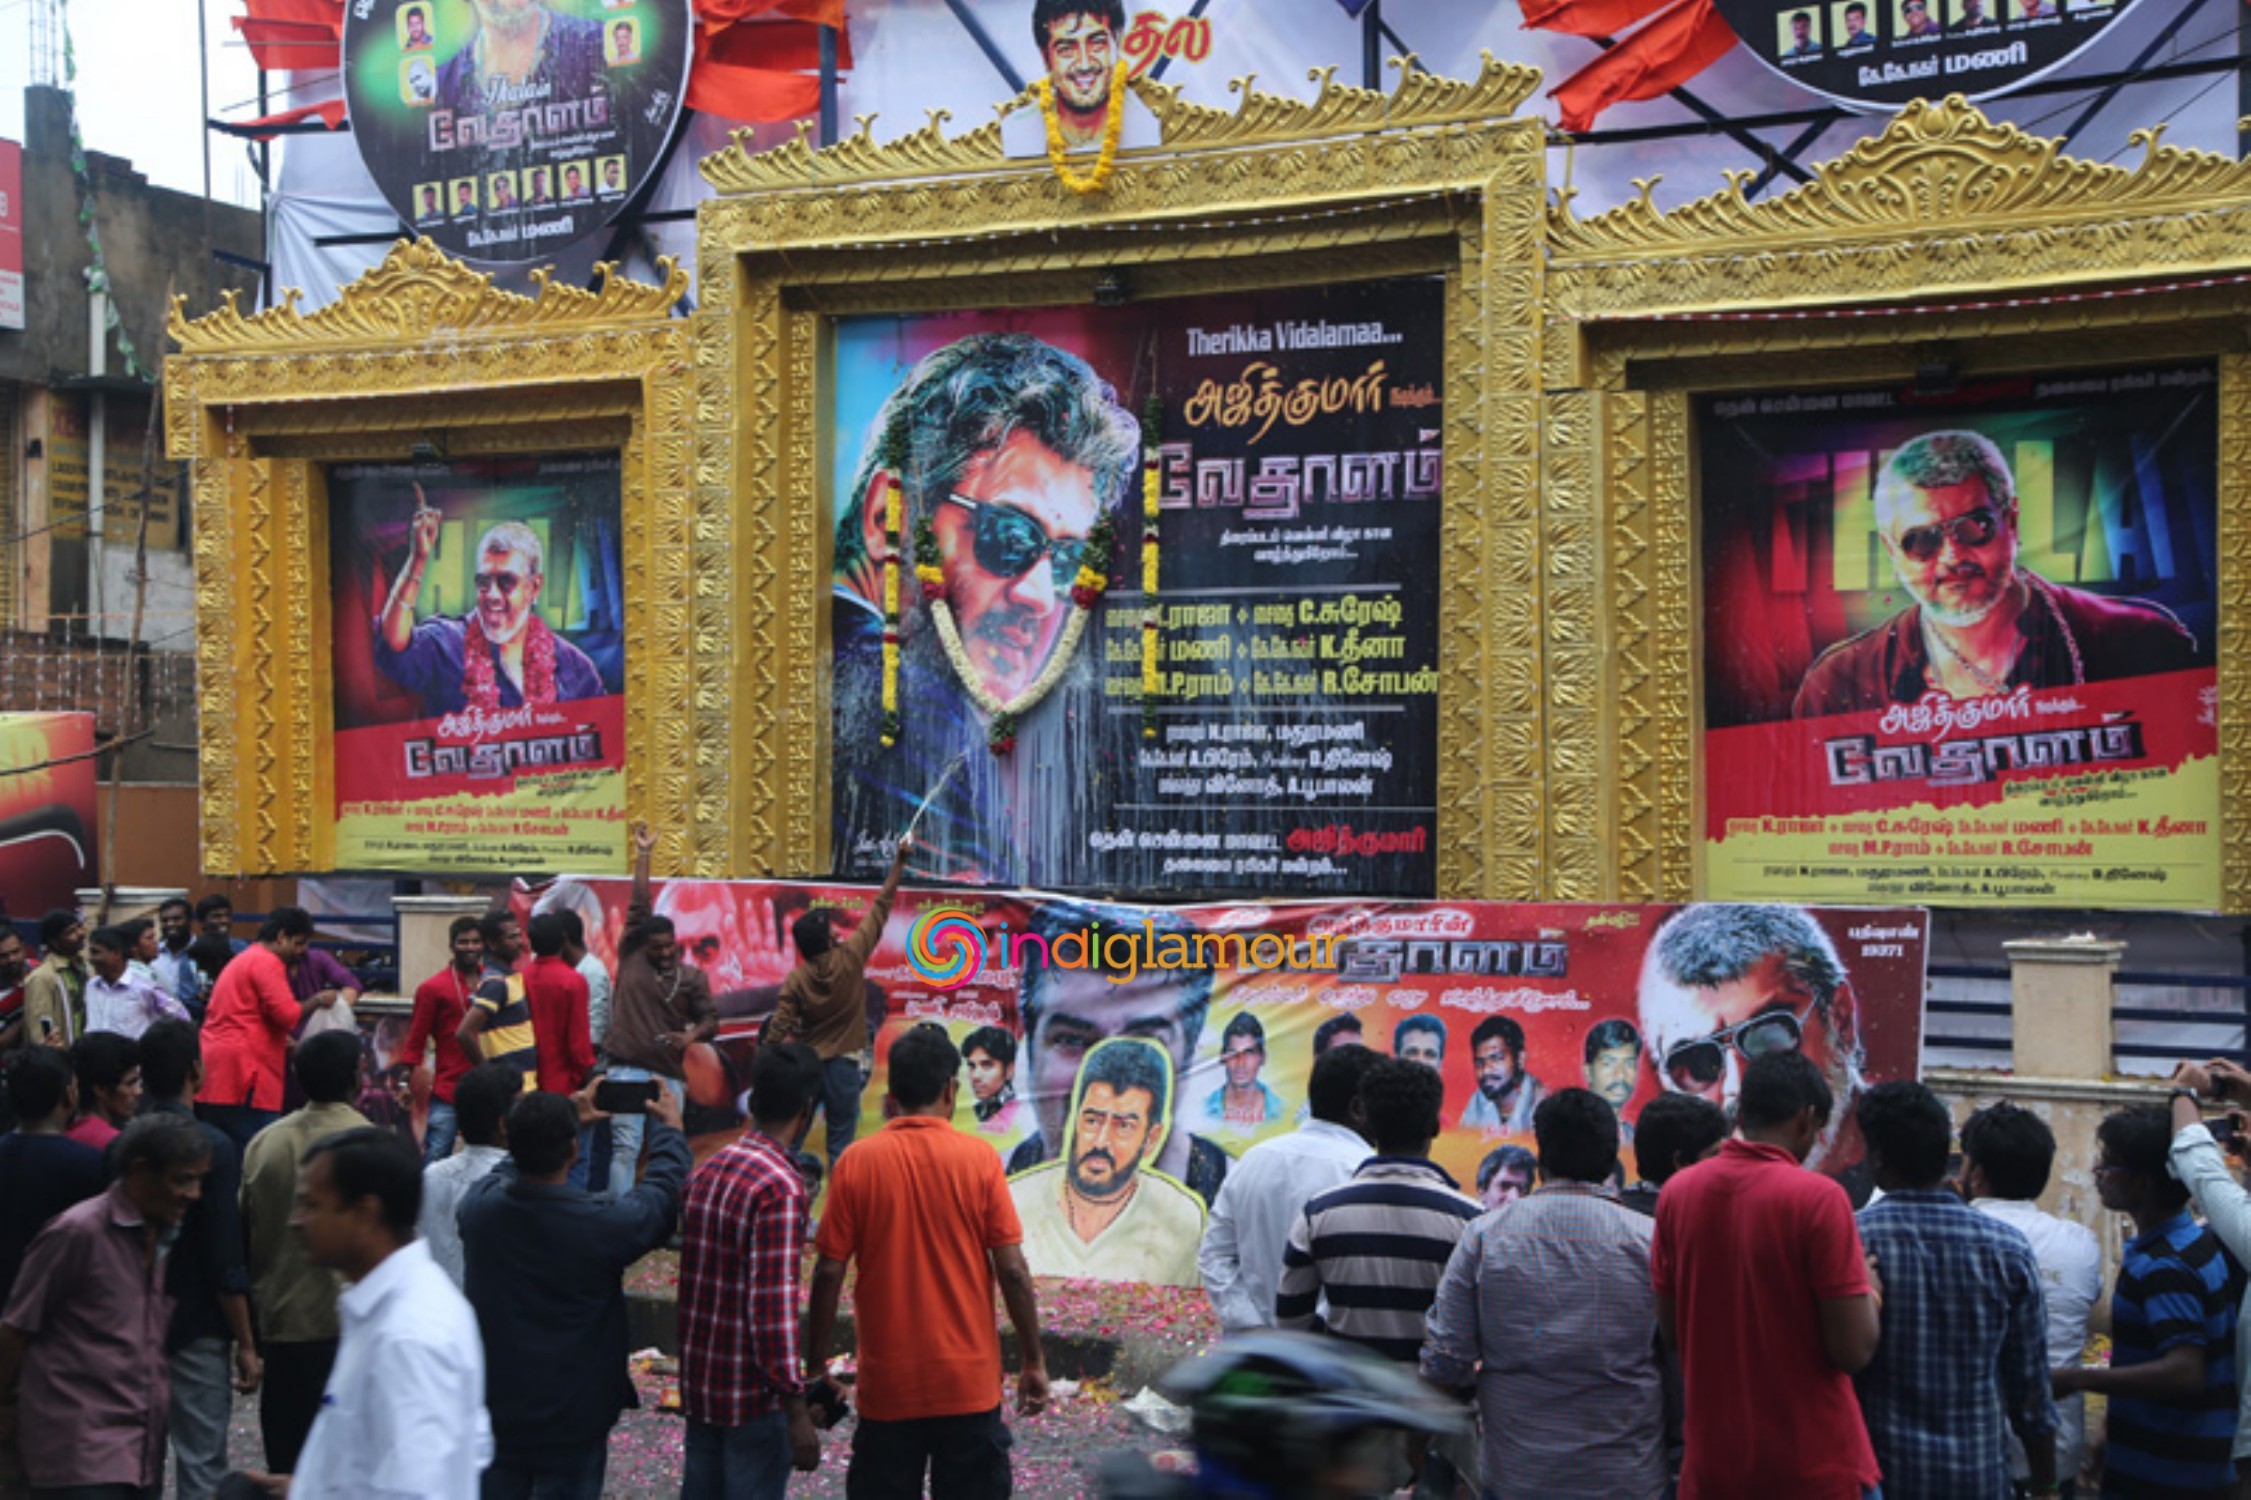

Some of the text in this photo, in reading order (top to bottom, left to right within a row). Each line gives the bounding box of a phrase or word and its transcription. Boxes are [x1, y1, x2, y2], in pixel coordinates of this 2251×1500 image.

[1123, 10, 1212, 79] தல
[1945, 41, 2026, 74] மணி
[429, 86, 607, 151] வேதாளம்
[1186, 319, 1403, 356] Therikka Vidalamaa...
[1184, 359, 1389, 445] அஜித்குமார்
[1158, 428, 1442, 519] வேதாளம்
[1170, 633, 1231, 660] மணி
[1880, 686, 2031, 742] அஜித்குமார்
[404, 723, 602, 779] வேதாளம்
[1825, 711, 2143, 787] வேதாளம்
